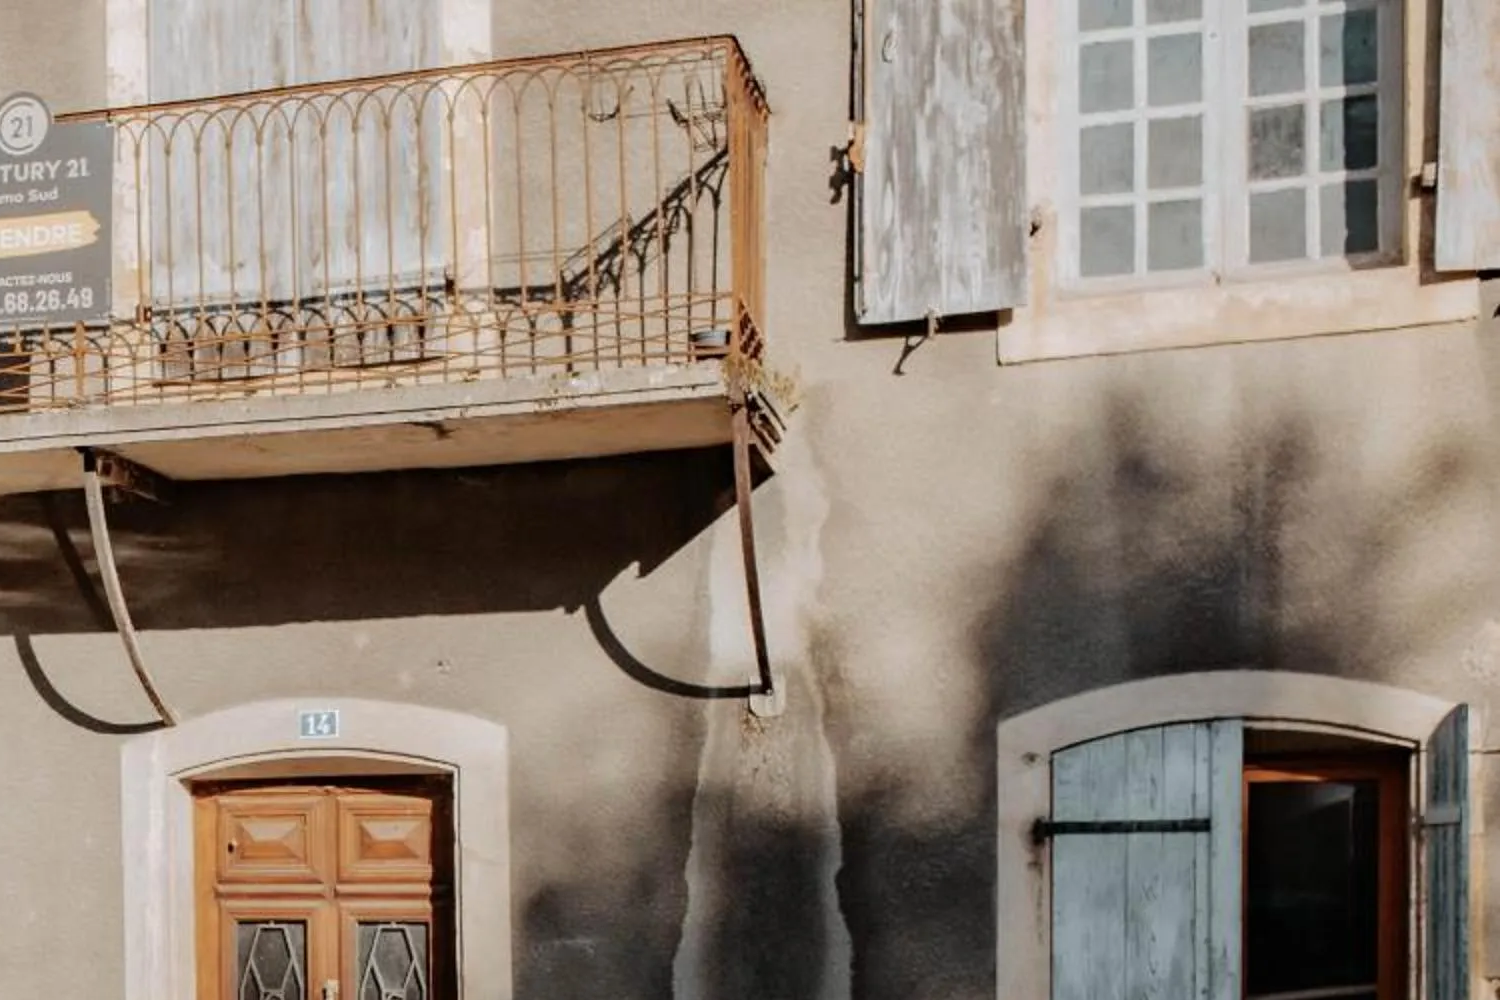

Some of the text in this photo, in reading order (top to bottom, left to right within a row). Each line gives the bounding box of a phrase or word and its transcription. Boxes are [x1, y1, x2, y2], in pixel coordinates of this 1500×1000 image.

[10, 115, 34, 139] 21
[66, 156, 91, 178] 21
[27, 186, 59, 203] Sud
[307, 714, 331, 735] 14
